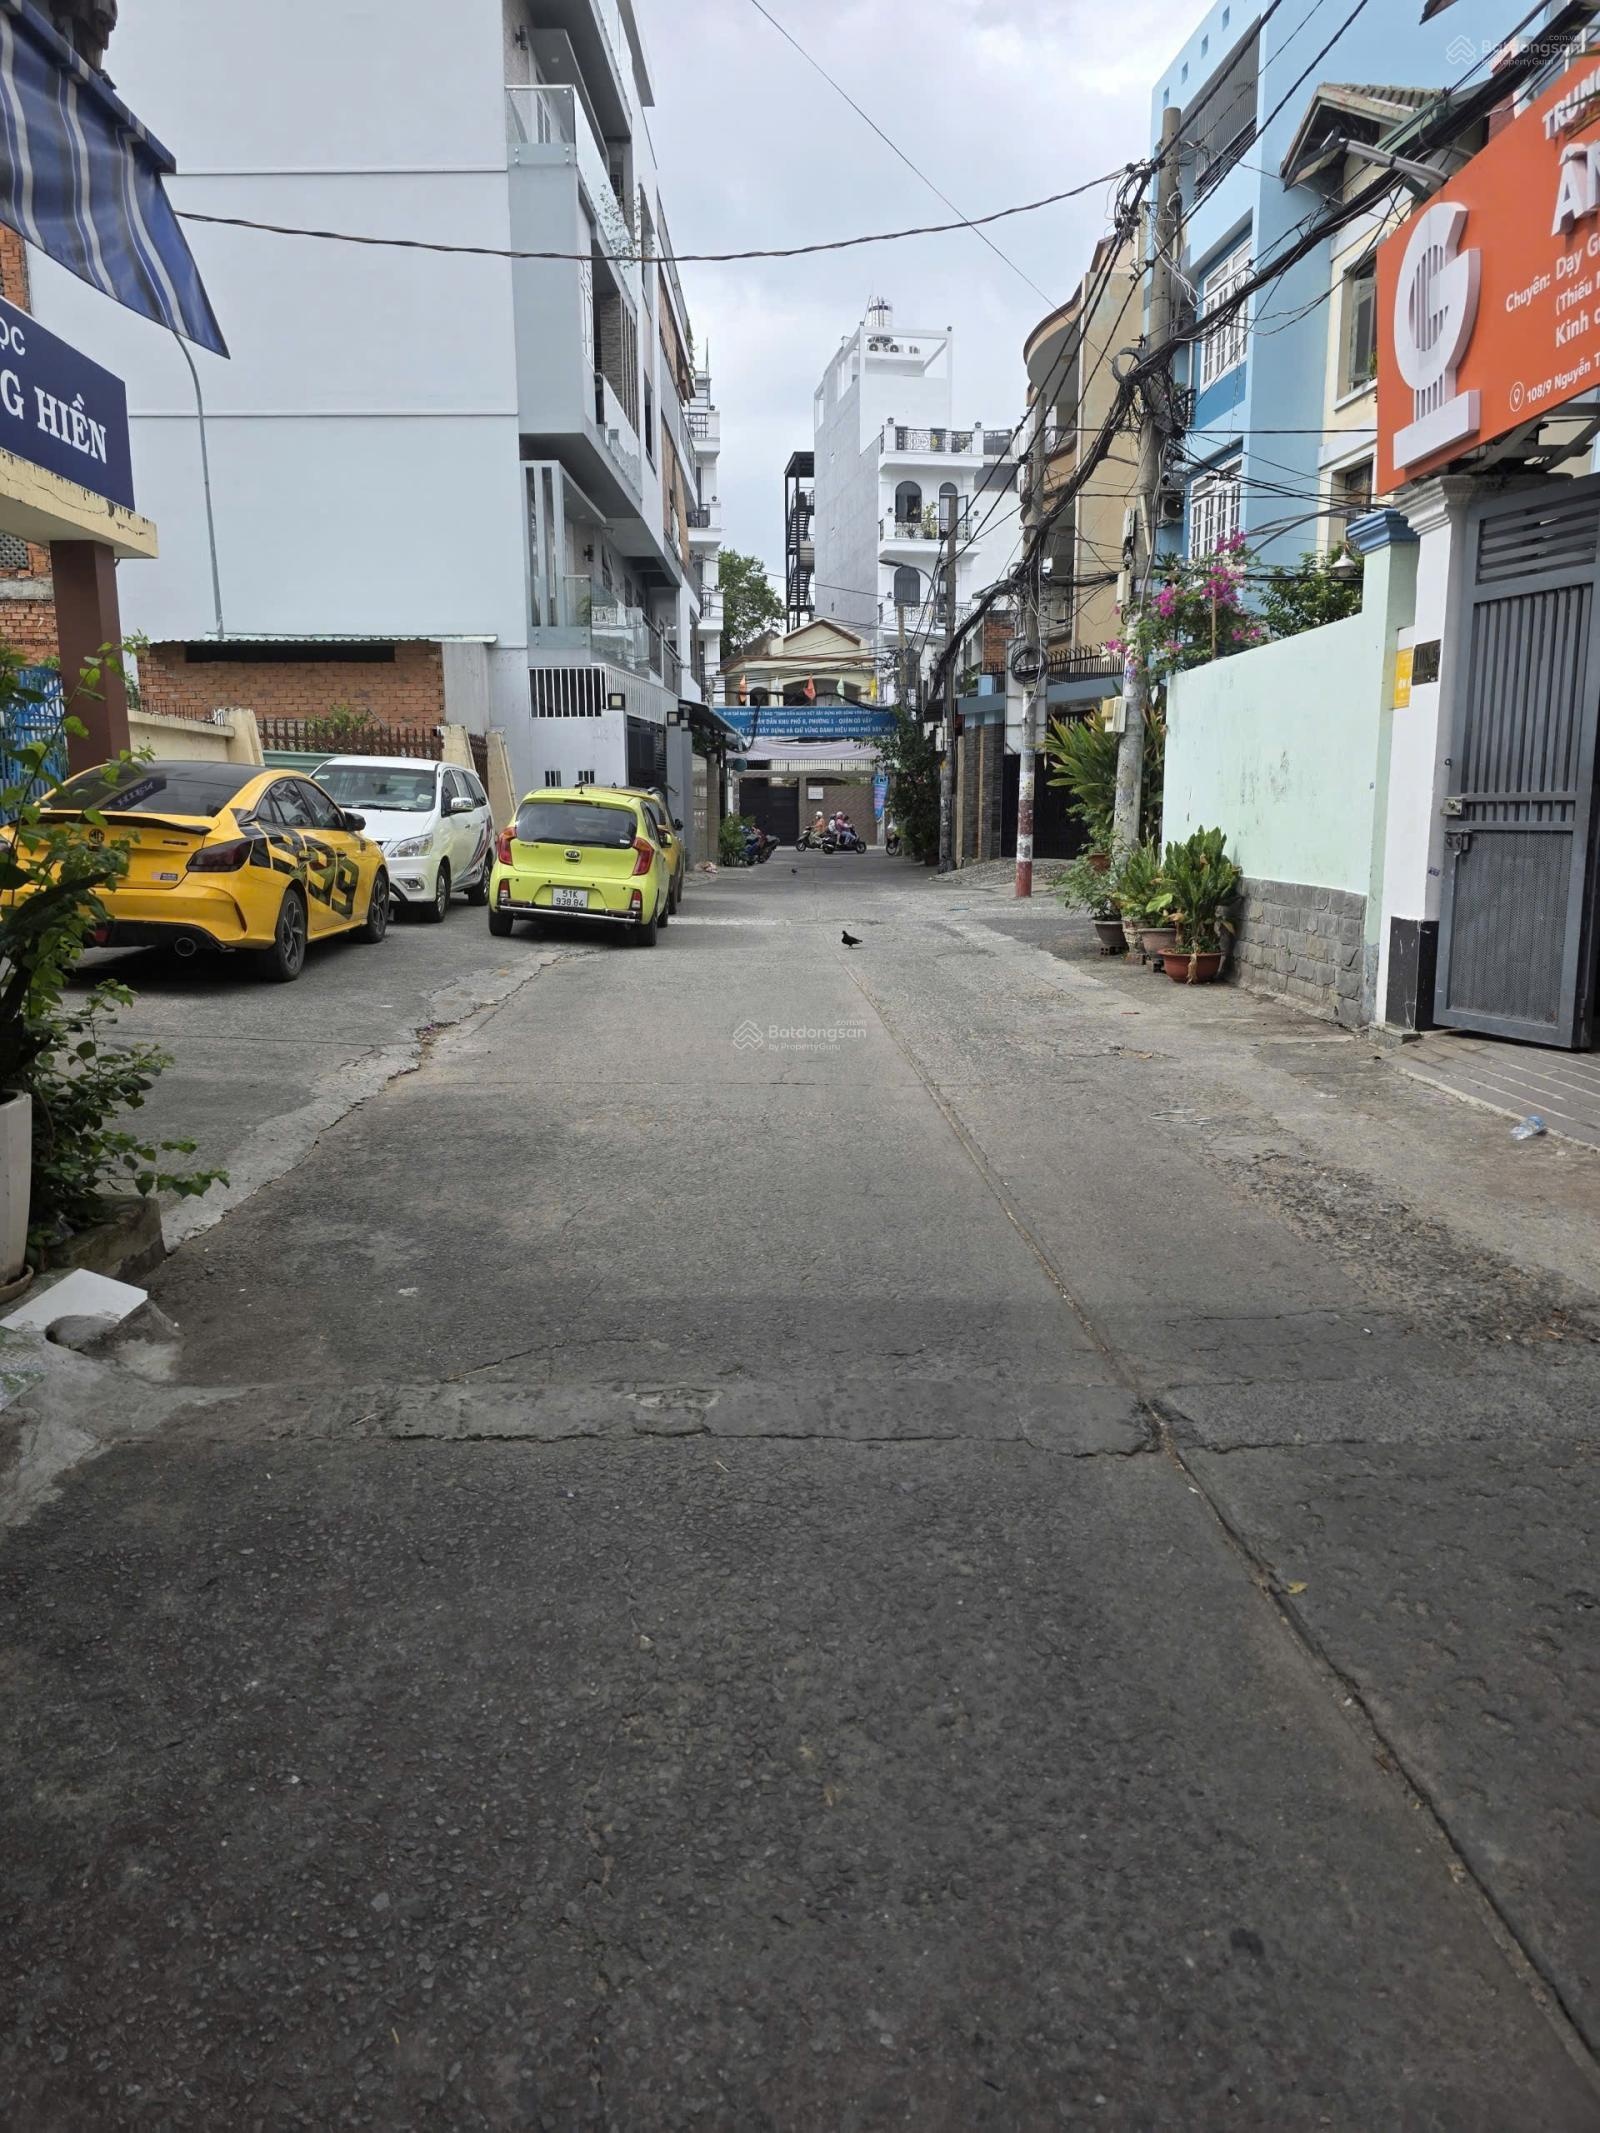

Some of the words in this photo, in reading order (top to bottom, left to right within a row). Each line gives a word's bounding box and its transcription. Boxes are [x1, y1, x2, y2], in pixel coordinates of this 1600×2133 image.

[1505, 273, 1551, 313] Chuyên:
[1555, 248, 1583, 280] Dạy
[1555, 276, 1593, 317] (Thiếu
[1555, 310, 1590, 348] Kinh
[1526, 379, 1552, 404] 108/9
[1554, 357, 1591, 391] Nguyễn
[33, 385, 107, 465] HIỀN
[562, 889, 578, 899] 51K
